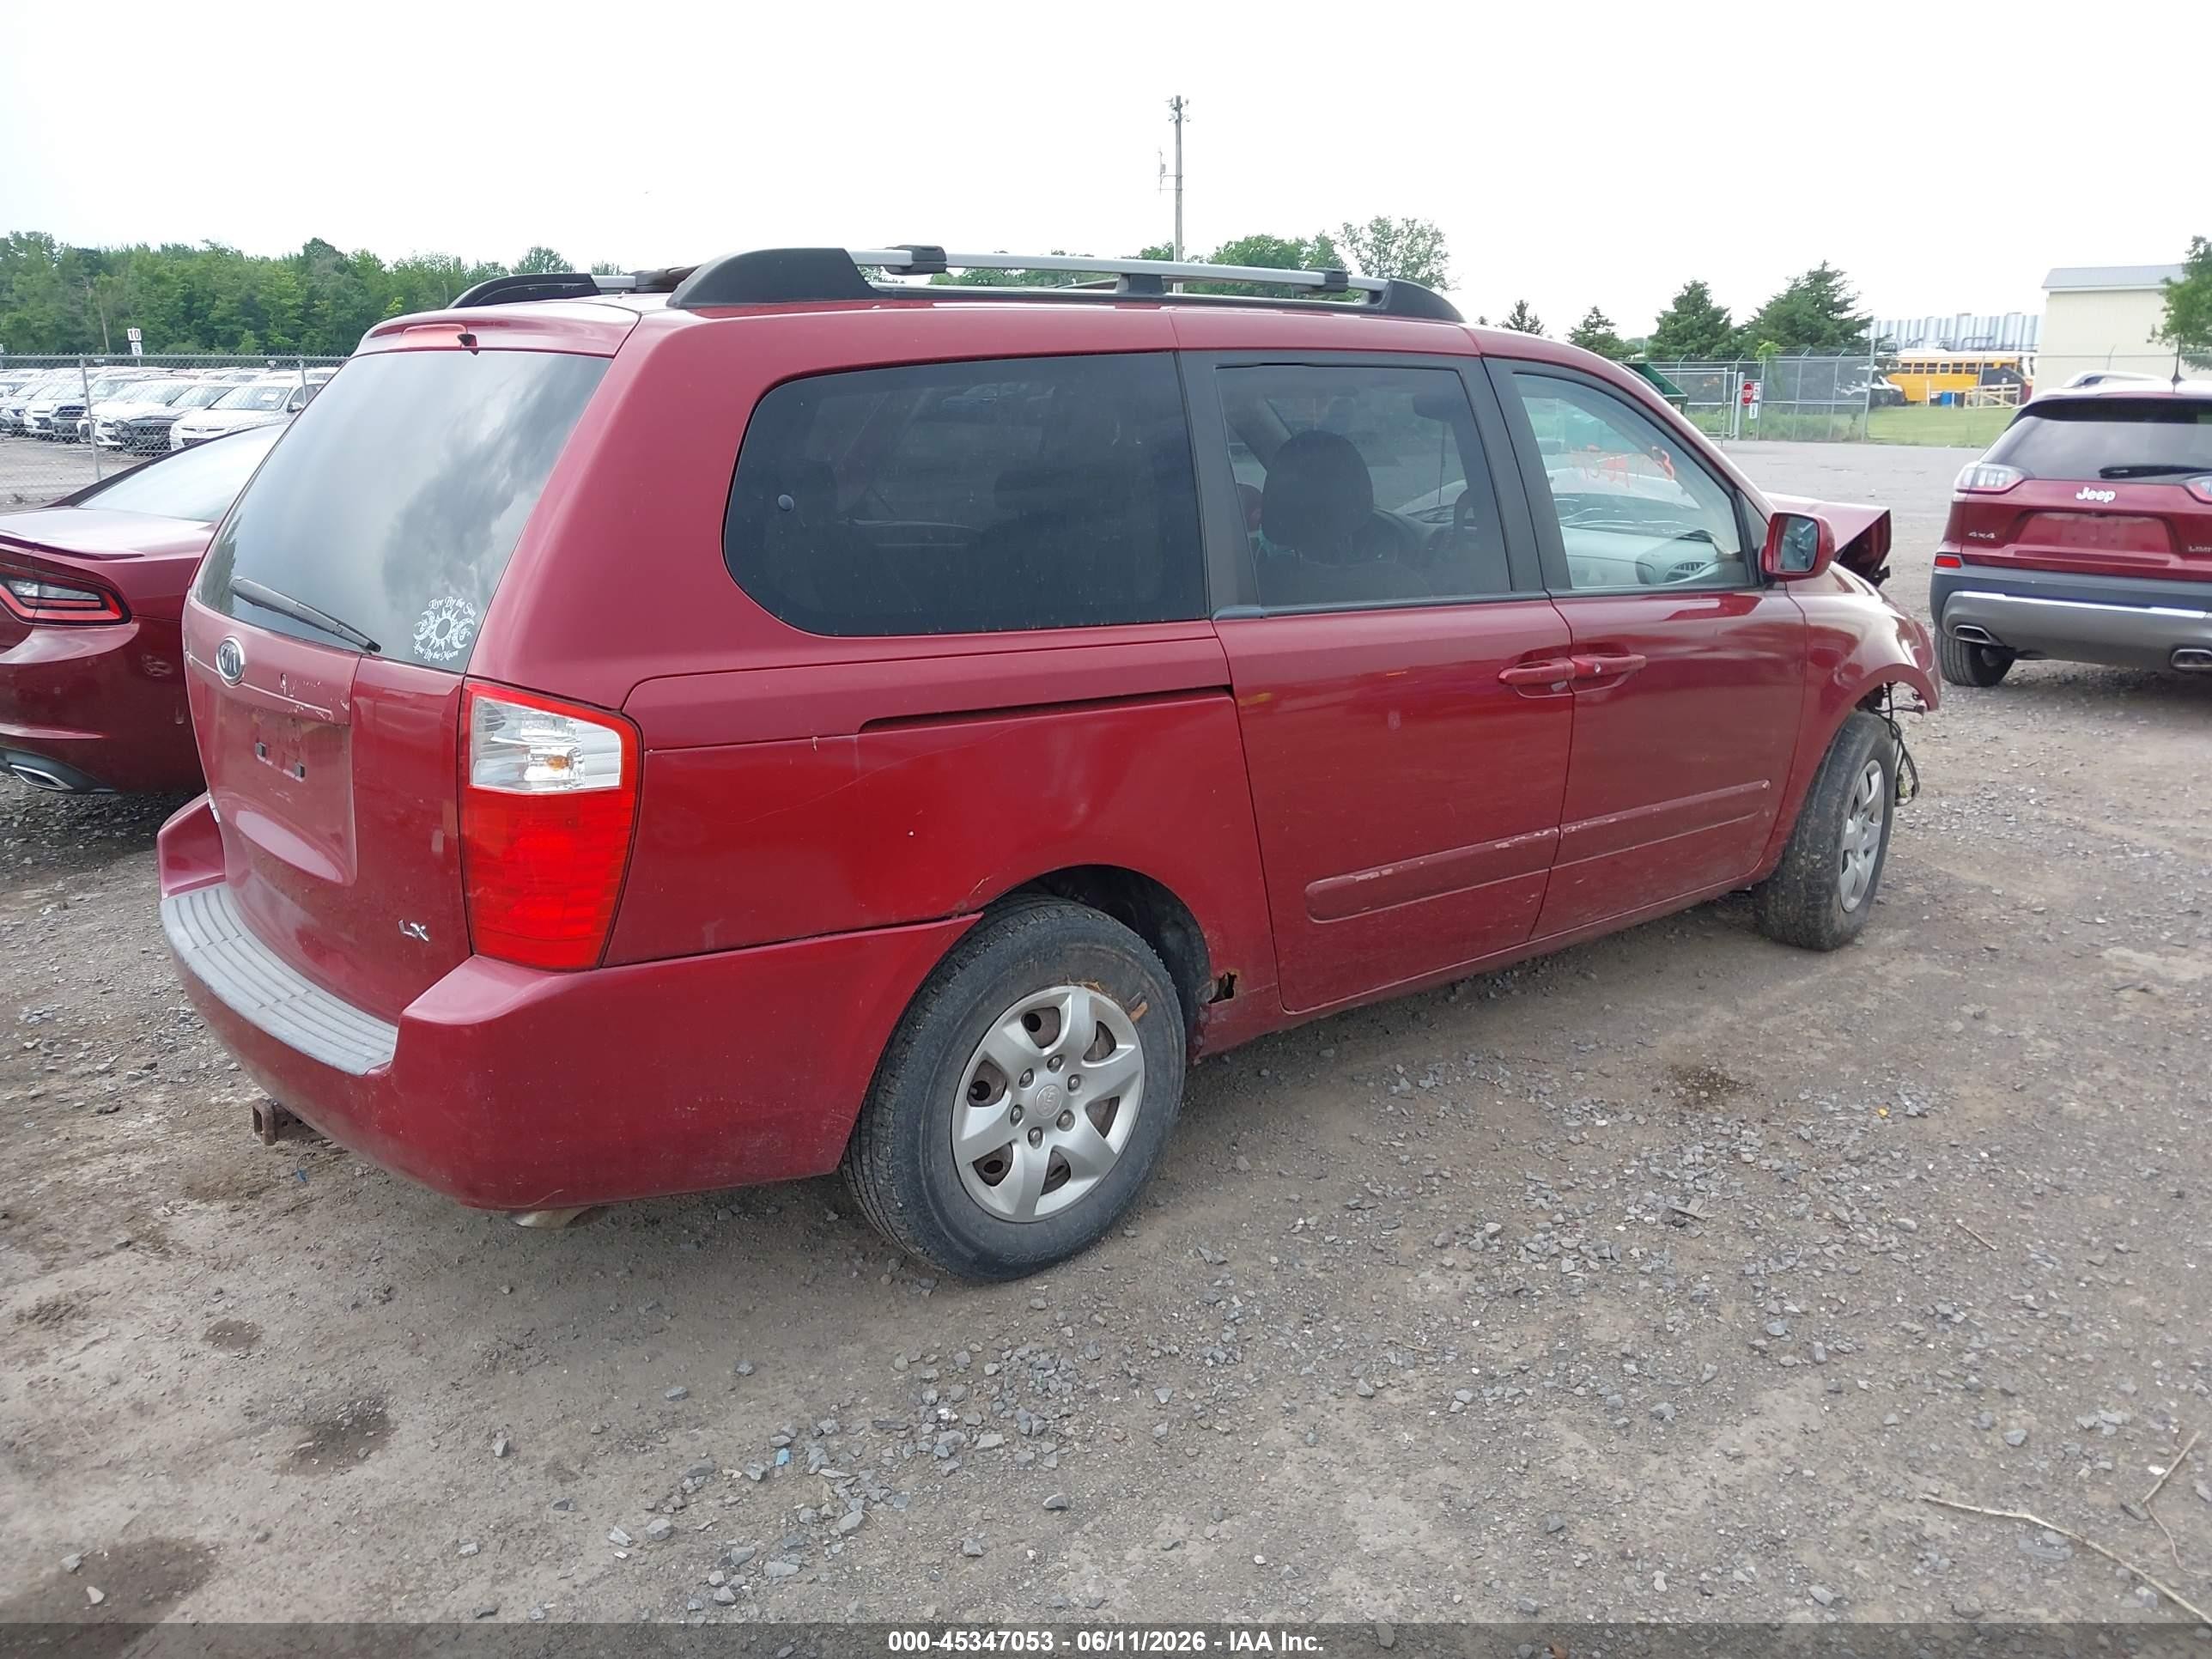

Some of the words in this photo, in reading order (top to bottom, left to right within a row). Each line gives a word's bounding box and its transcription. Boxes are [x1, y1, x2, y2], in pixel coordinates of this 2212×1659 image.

[129, 330, 140, 339] 10
[2075, 487, 2117, 504] Jeep
[398, 919, 429, 942] LX
